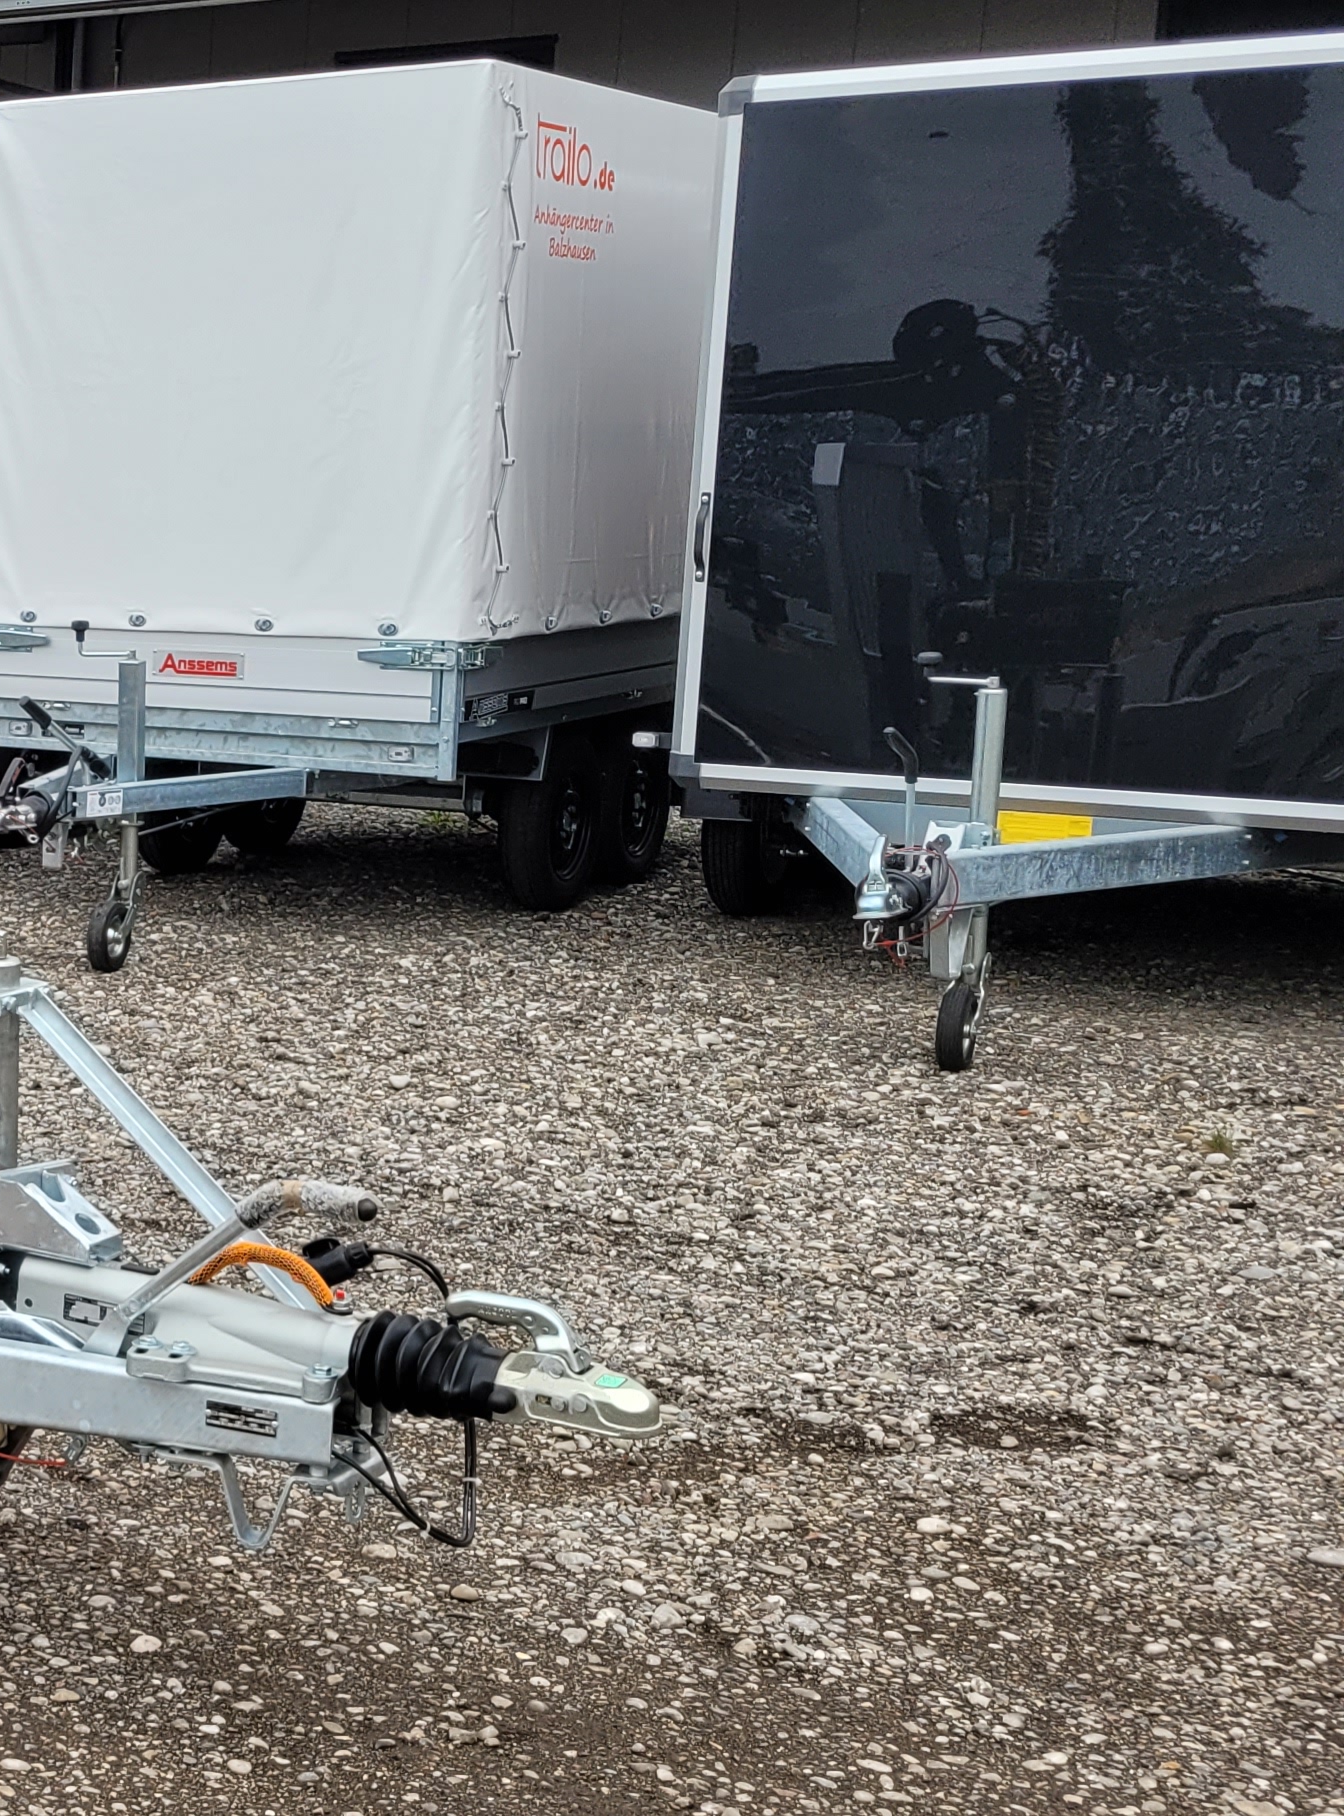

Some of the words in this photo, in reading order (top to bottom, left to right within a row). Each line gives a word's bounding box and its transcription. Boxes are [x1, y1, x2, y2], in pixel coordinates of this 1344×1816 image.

[534, 204, 604, 235] Anhängercenter
[605, 213, 614, 234] in
[548, 236, 596, 261] Balzhausen
[159, 653, 237, 676] Anssems
